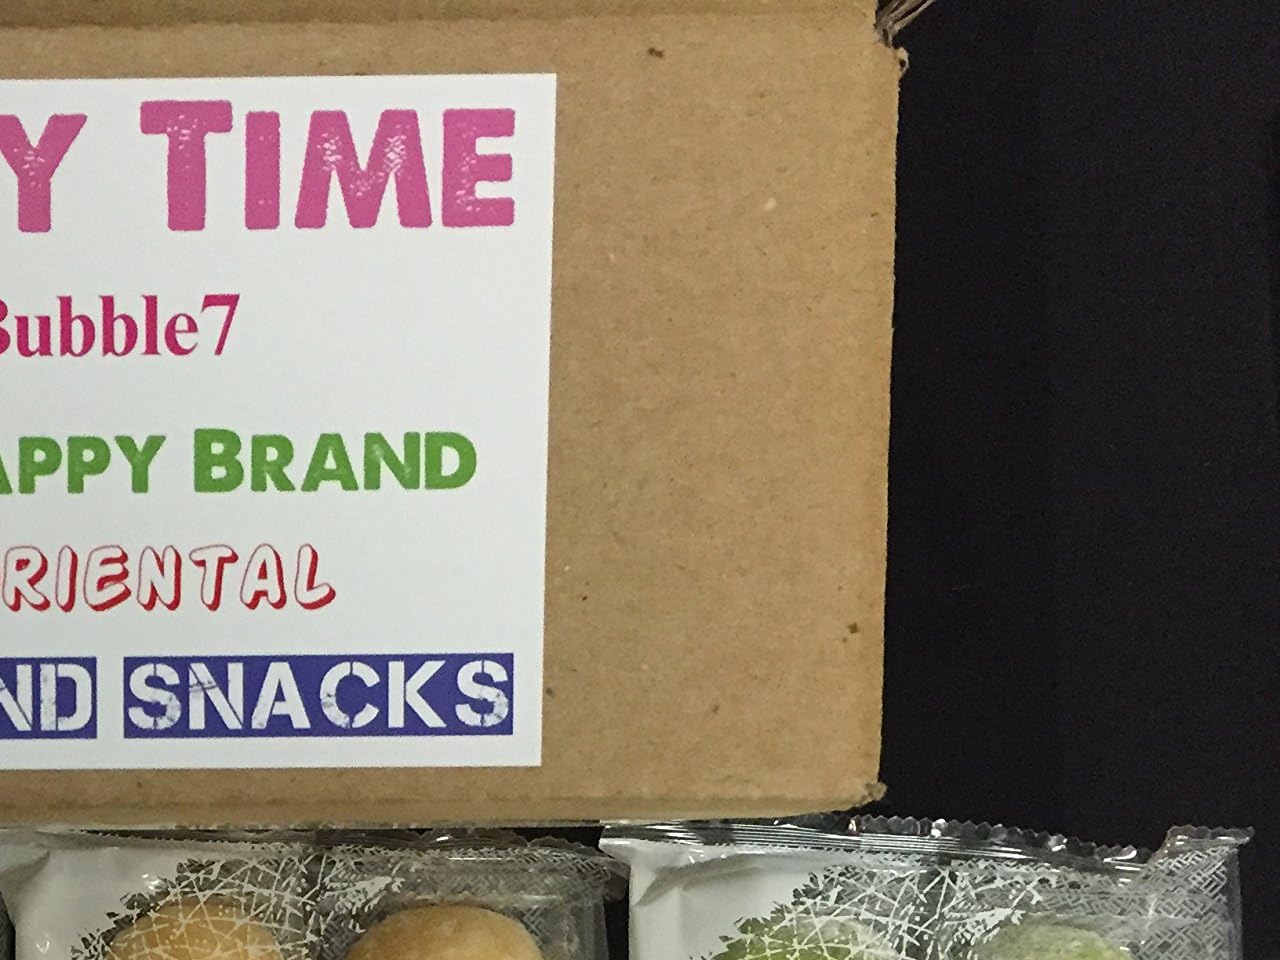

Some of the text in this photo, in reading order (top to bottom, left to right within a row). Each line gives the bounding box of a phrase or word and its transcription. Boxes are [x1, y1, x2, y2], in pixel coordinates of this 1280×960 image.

[139, 98, 516, 232] TIME
[192, 428, 478, 494] BRAND
[127, 657, 512, 734] SNACKS
